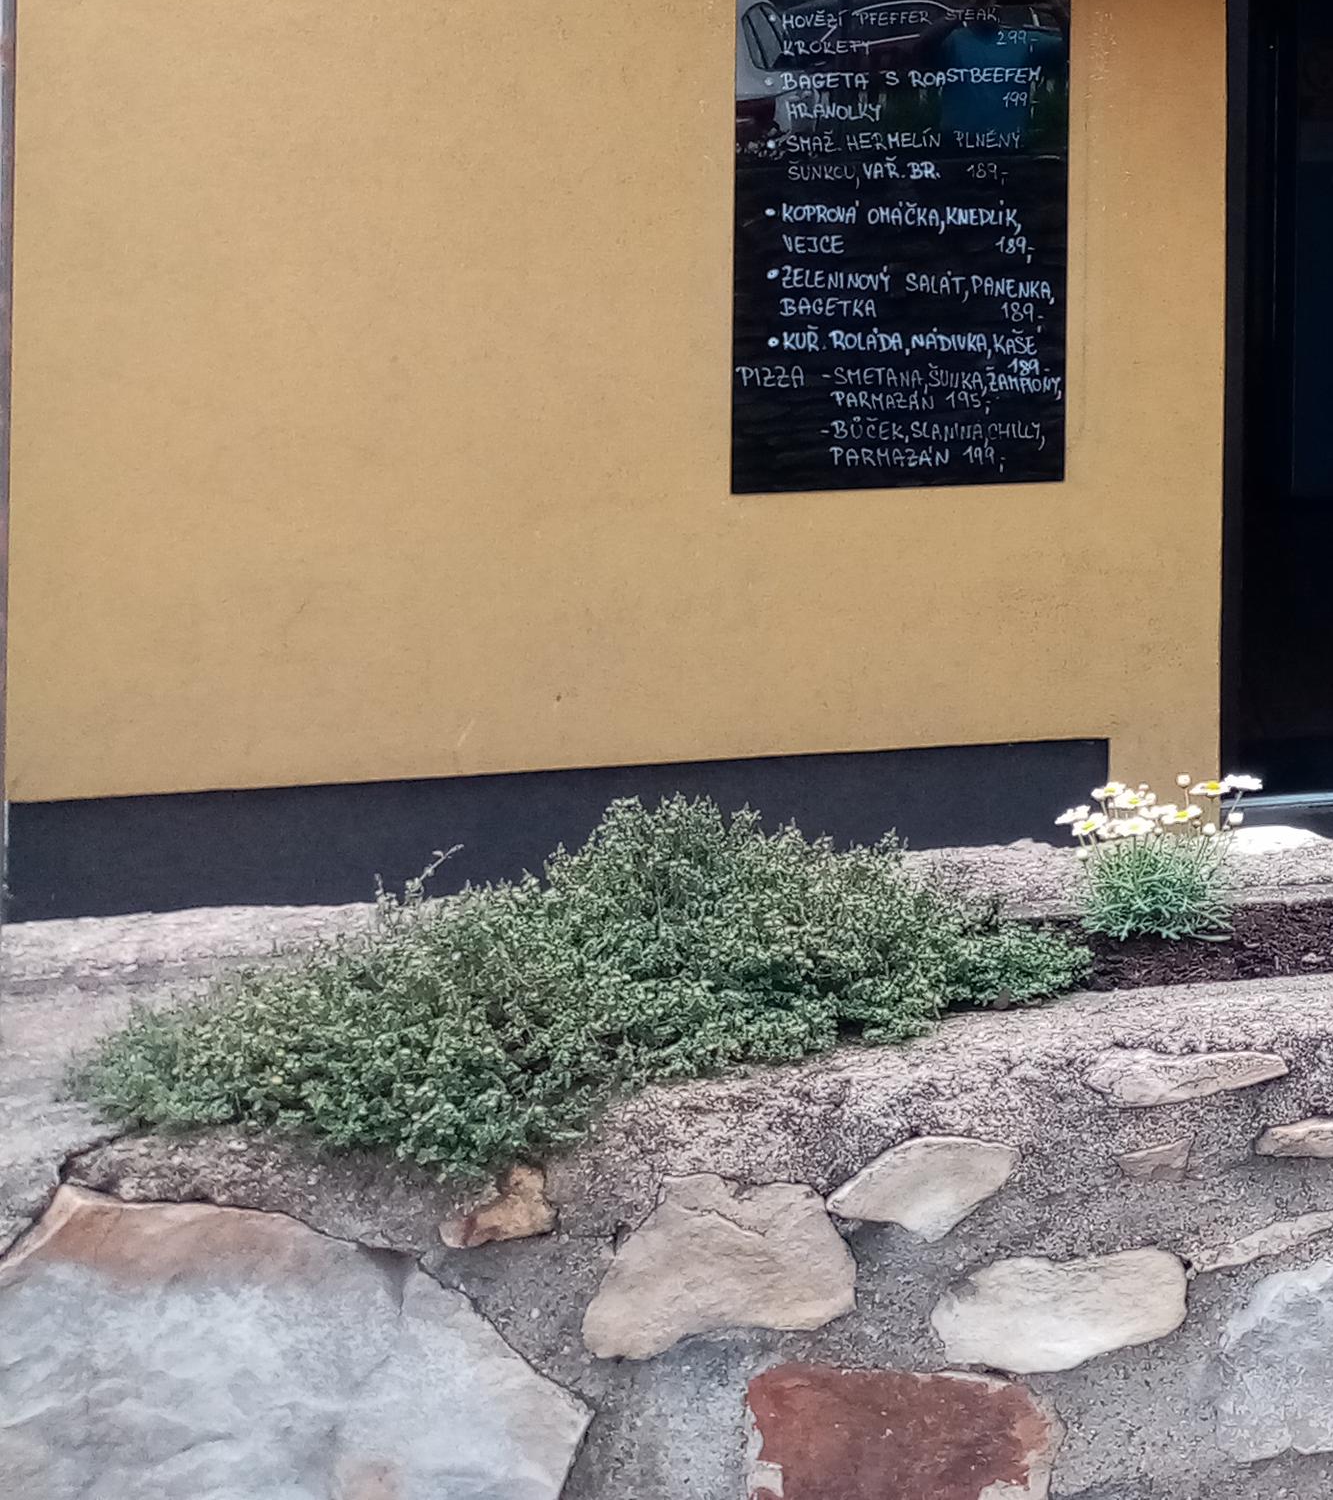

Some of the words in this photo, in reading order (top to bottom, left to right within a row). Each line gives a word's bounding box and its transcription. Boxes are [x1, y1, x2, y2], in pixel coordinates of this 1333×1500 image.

[857, 10, 933, 27] PFEFFER
[782, 40, 871, 56] KROKETY
[780, 71, 869, 90] BAGETA
[884, 70, 900, 86] S
[785, 101, 882, 123] HRANOLKY
[846, 127, 942, 151] HERMELÍN
[781, 199, 860, 225] KOPROVÁ
[782, 233, 845, 254] VEJCE
[781, 264, 891, 293] ZELENINOVÝ
[779, 297, 878, 318] BAGETKA
[992, 328, 1038, 355] KAŠE
[734, 364, 806, 389] PIZZA
[829, 390, 935, 411] PARMAZÁN
[828, 446, 949, 468] PARMAZÁN
